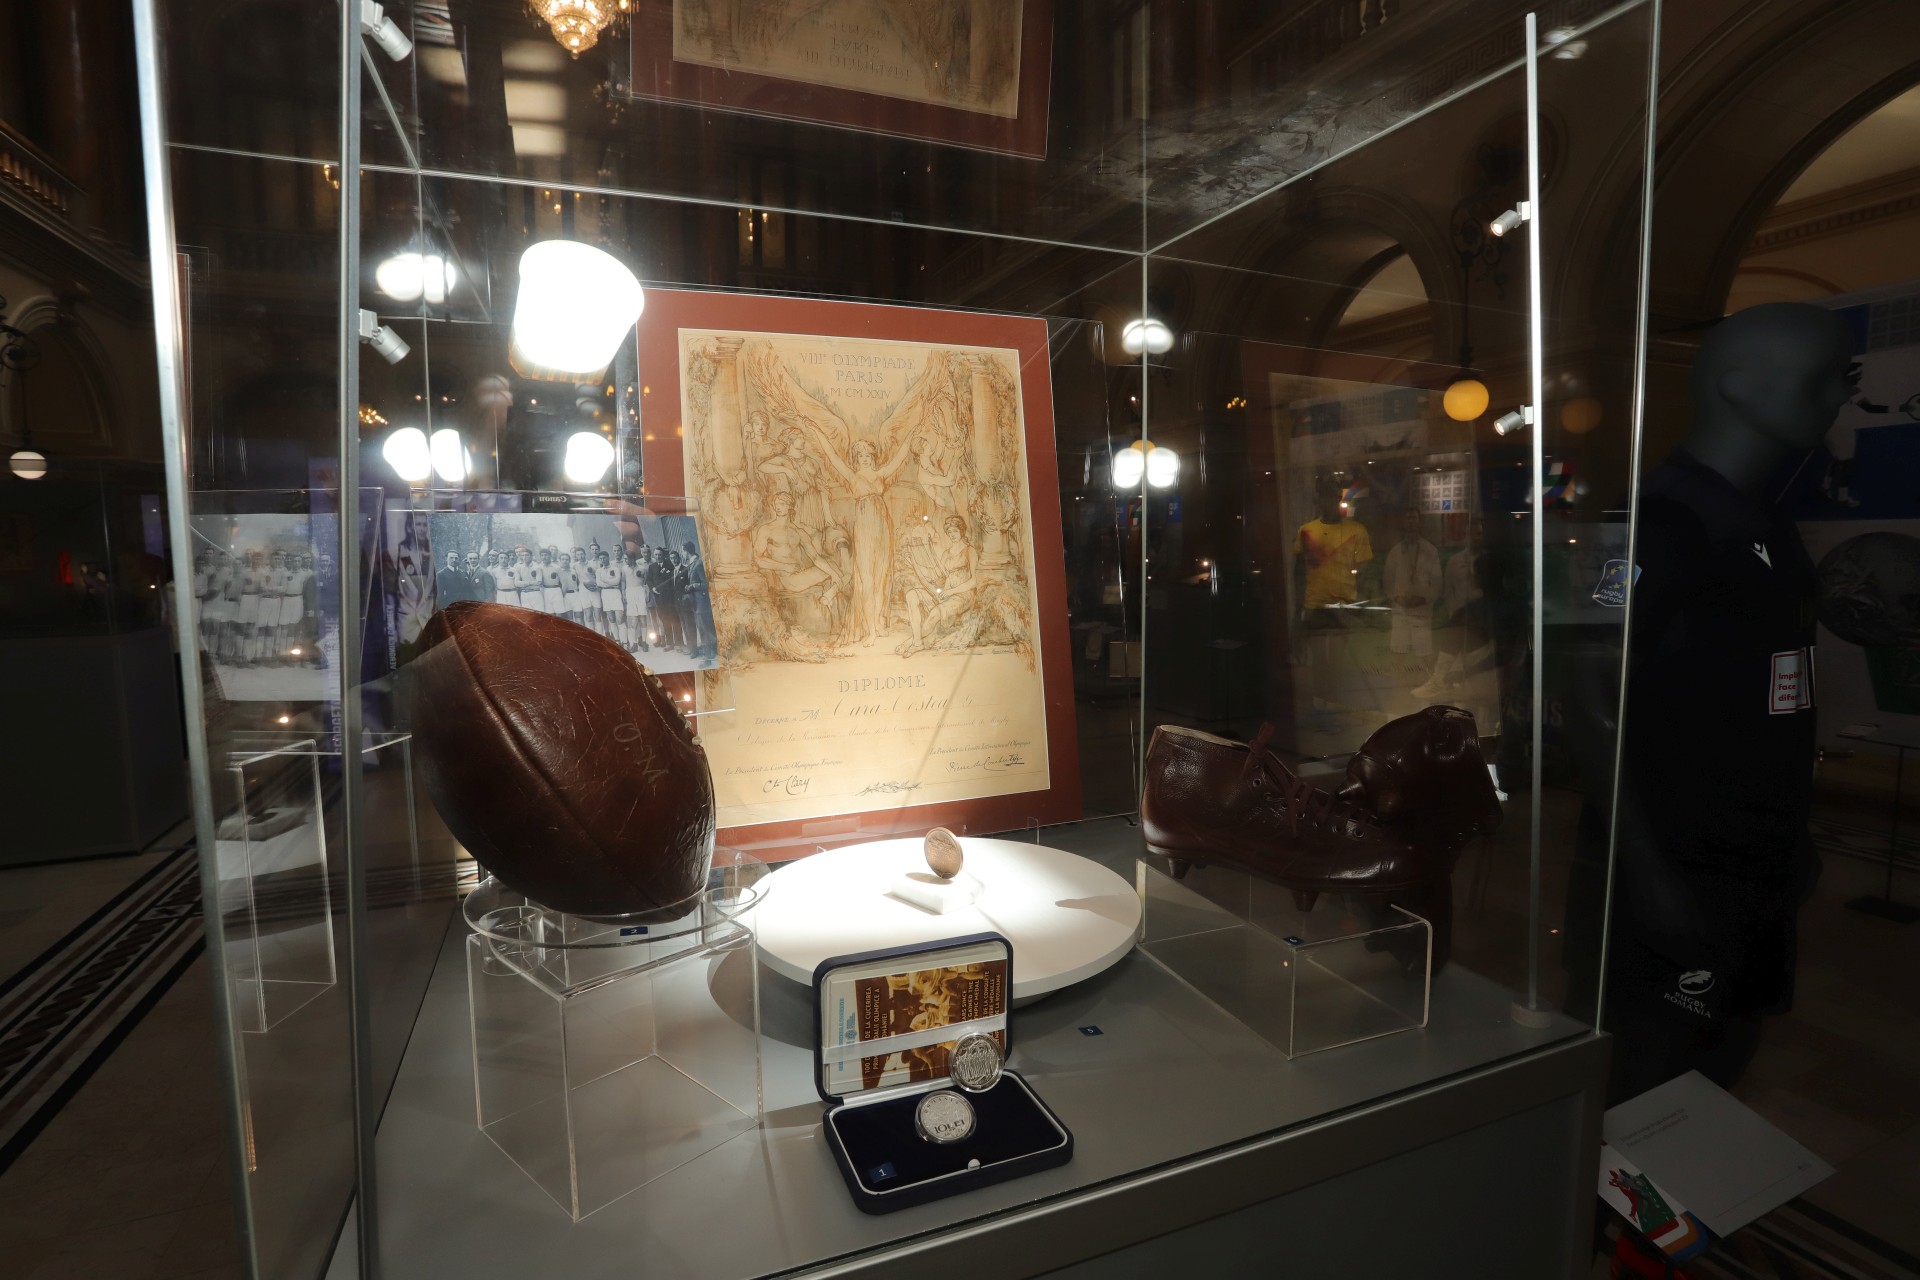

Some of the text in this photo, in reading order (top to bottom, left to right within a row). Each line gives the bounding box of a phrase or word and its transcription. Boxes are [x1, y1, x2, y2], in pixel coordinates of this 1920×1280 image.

[832, 353, 915, 370] OLYMPIADE
[835, 370, 884, 385] PARIS
[1600, 588, 1624, 599] rugby
[838, 674, 926, 693] DIPLOME
[1675, 991, 1705, 1009] RUGBY
[865, 1021, 871, 1029] LA
[865, 1030, 871, 1039] DE
[878, 1168, 887, 1177] 1
